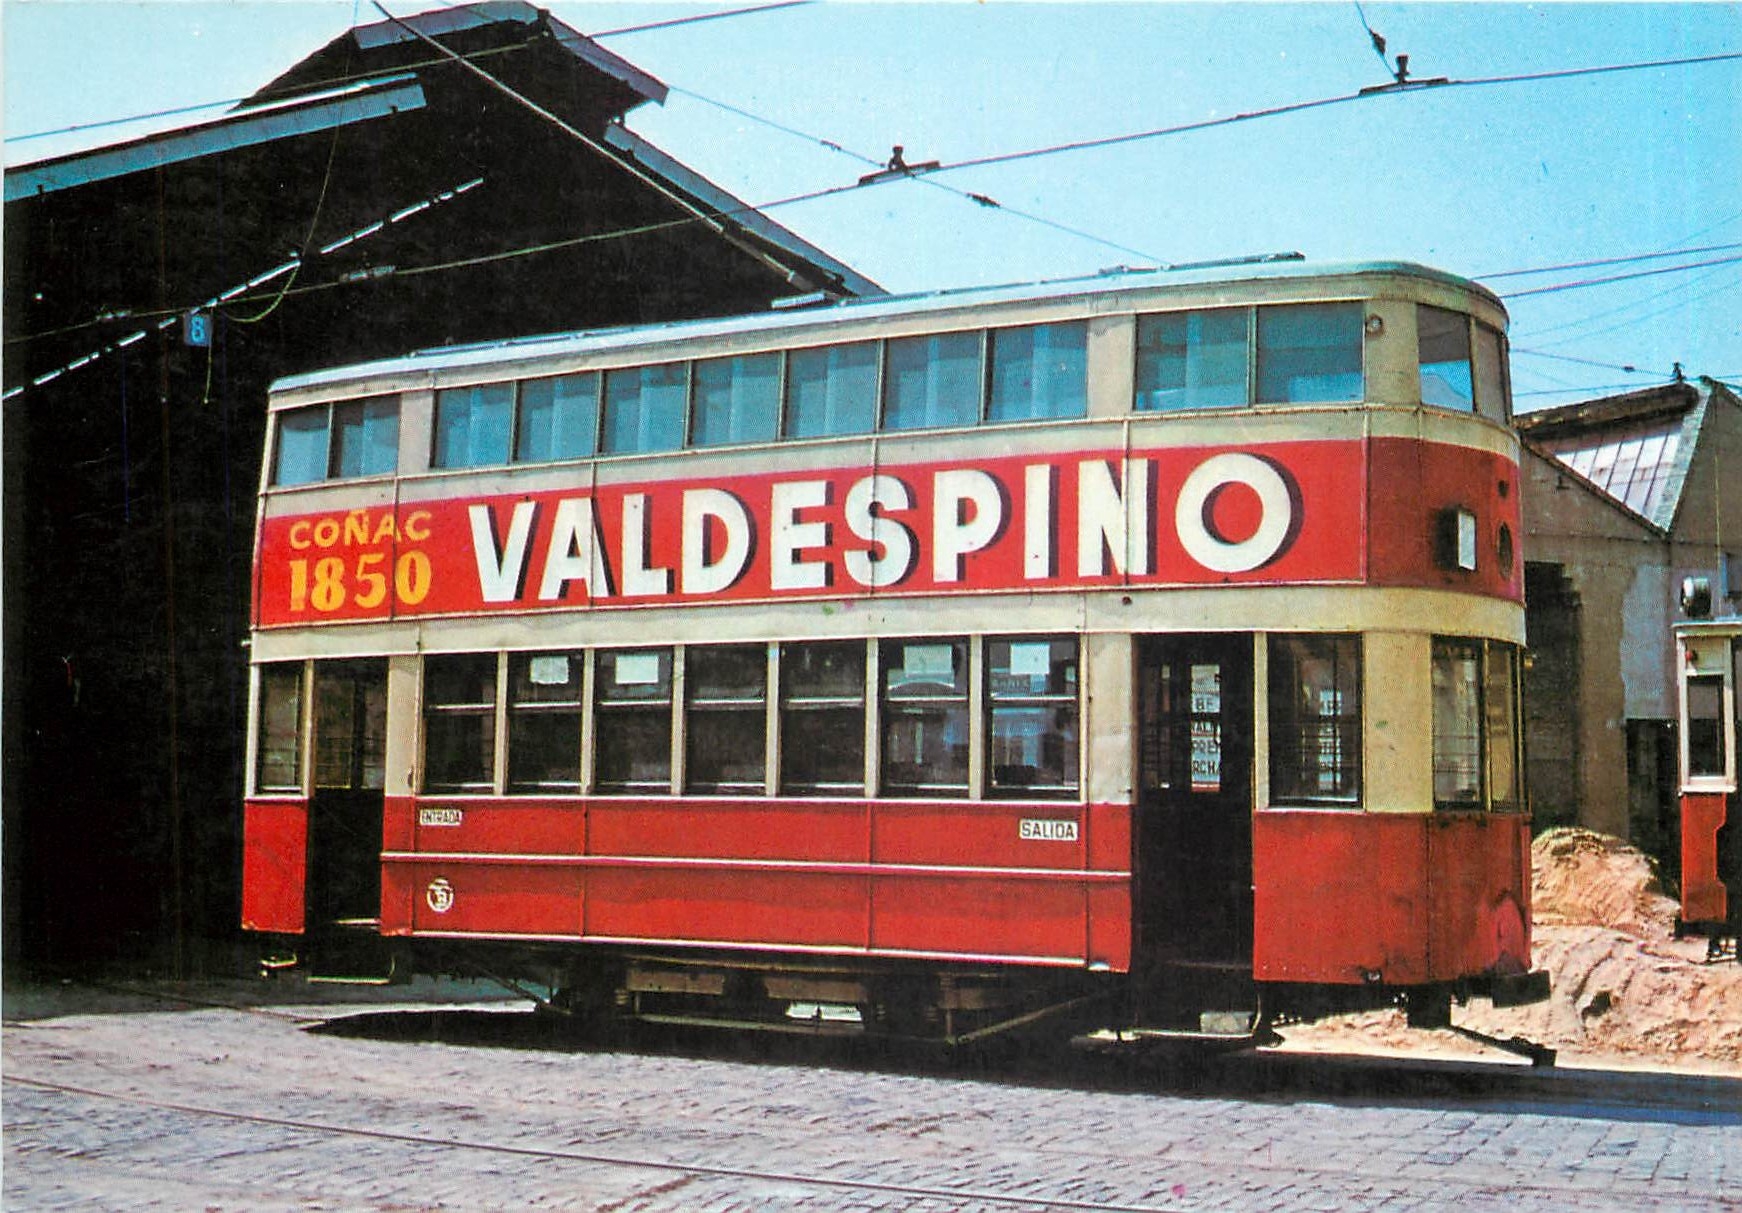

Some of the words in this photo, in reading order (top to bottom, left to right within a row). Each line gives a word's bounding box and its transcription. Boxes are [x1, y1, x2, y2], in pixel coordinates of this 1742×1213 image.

[191, 315, 205, 342] 8
[289, 509, 432, 549] COÑAC
[468, 452, 1300, 602] VALDESPINO
[289, 550, 432, 612] 1850
[1021, 821, 1075, 839] SALIDA
